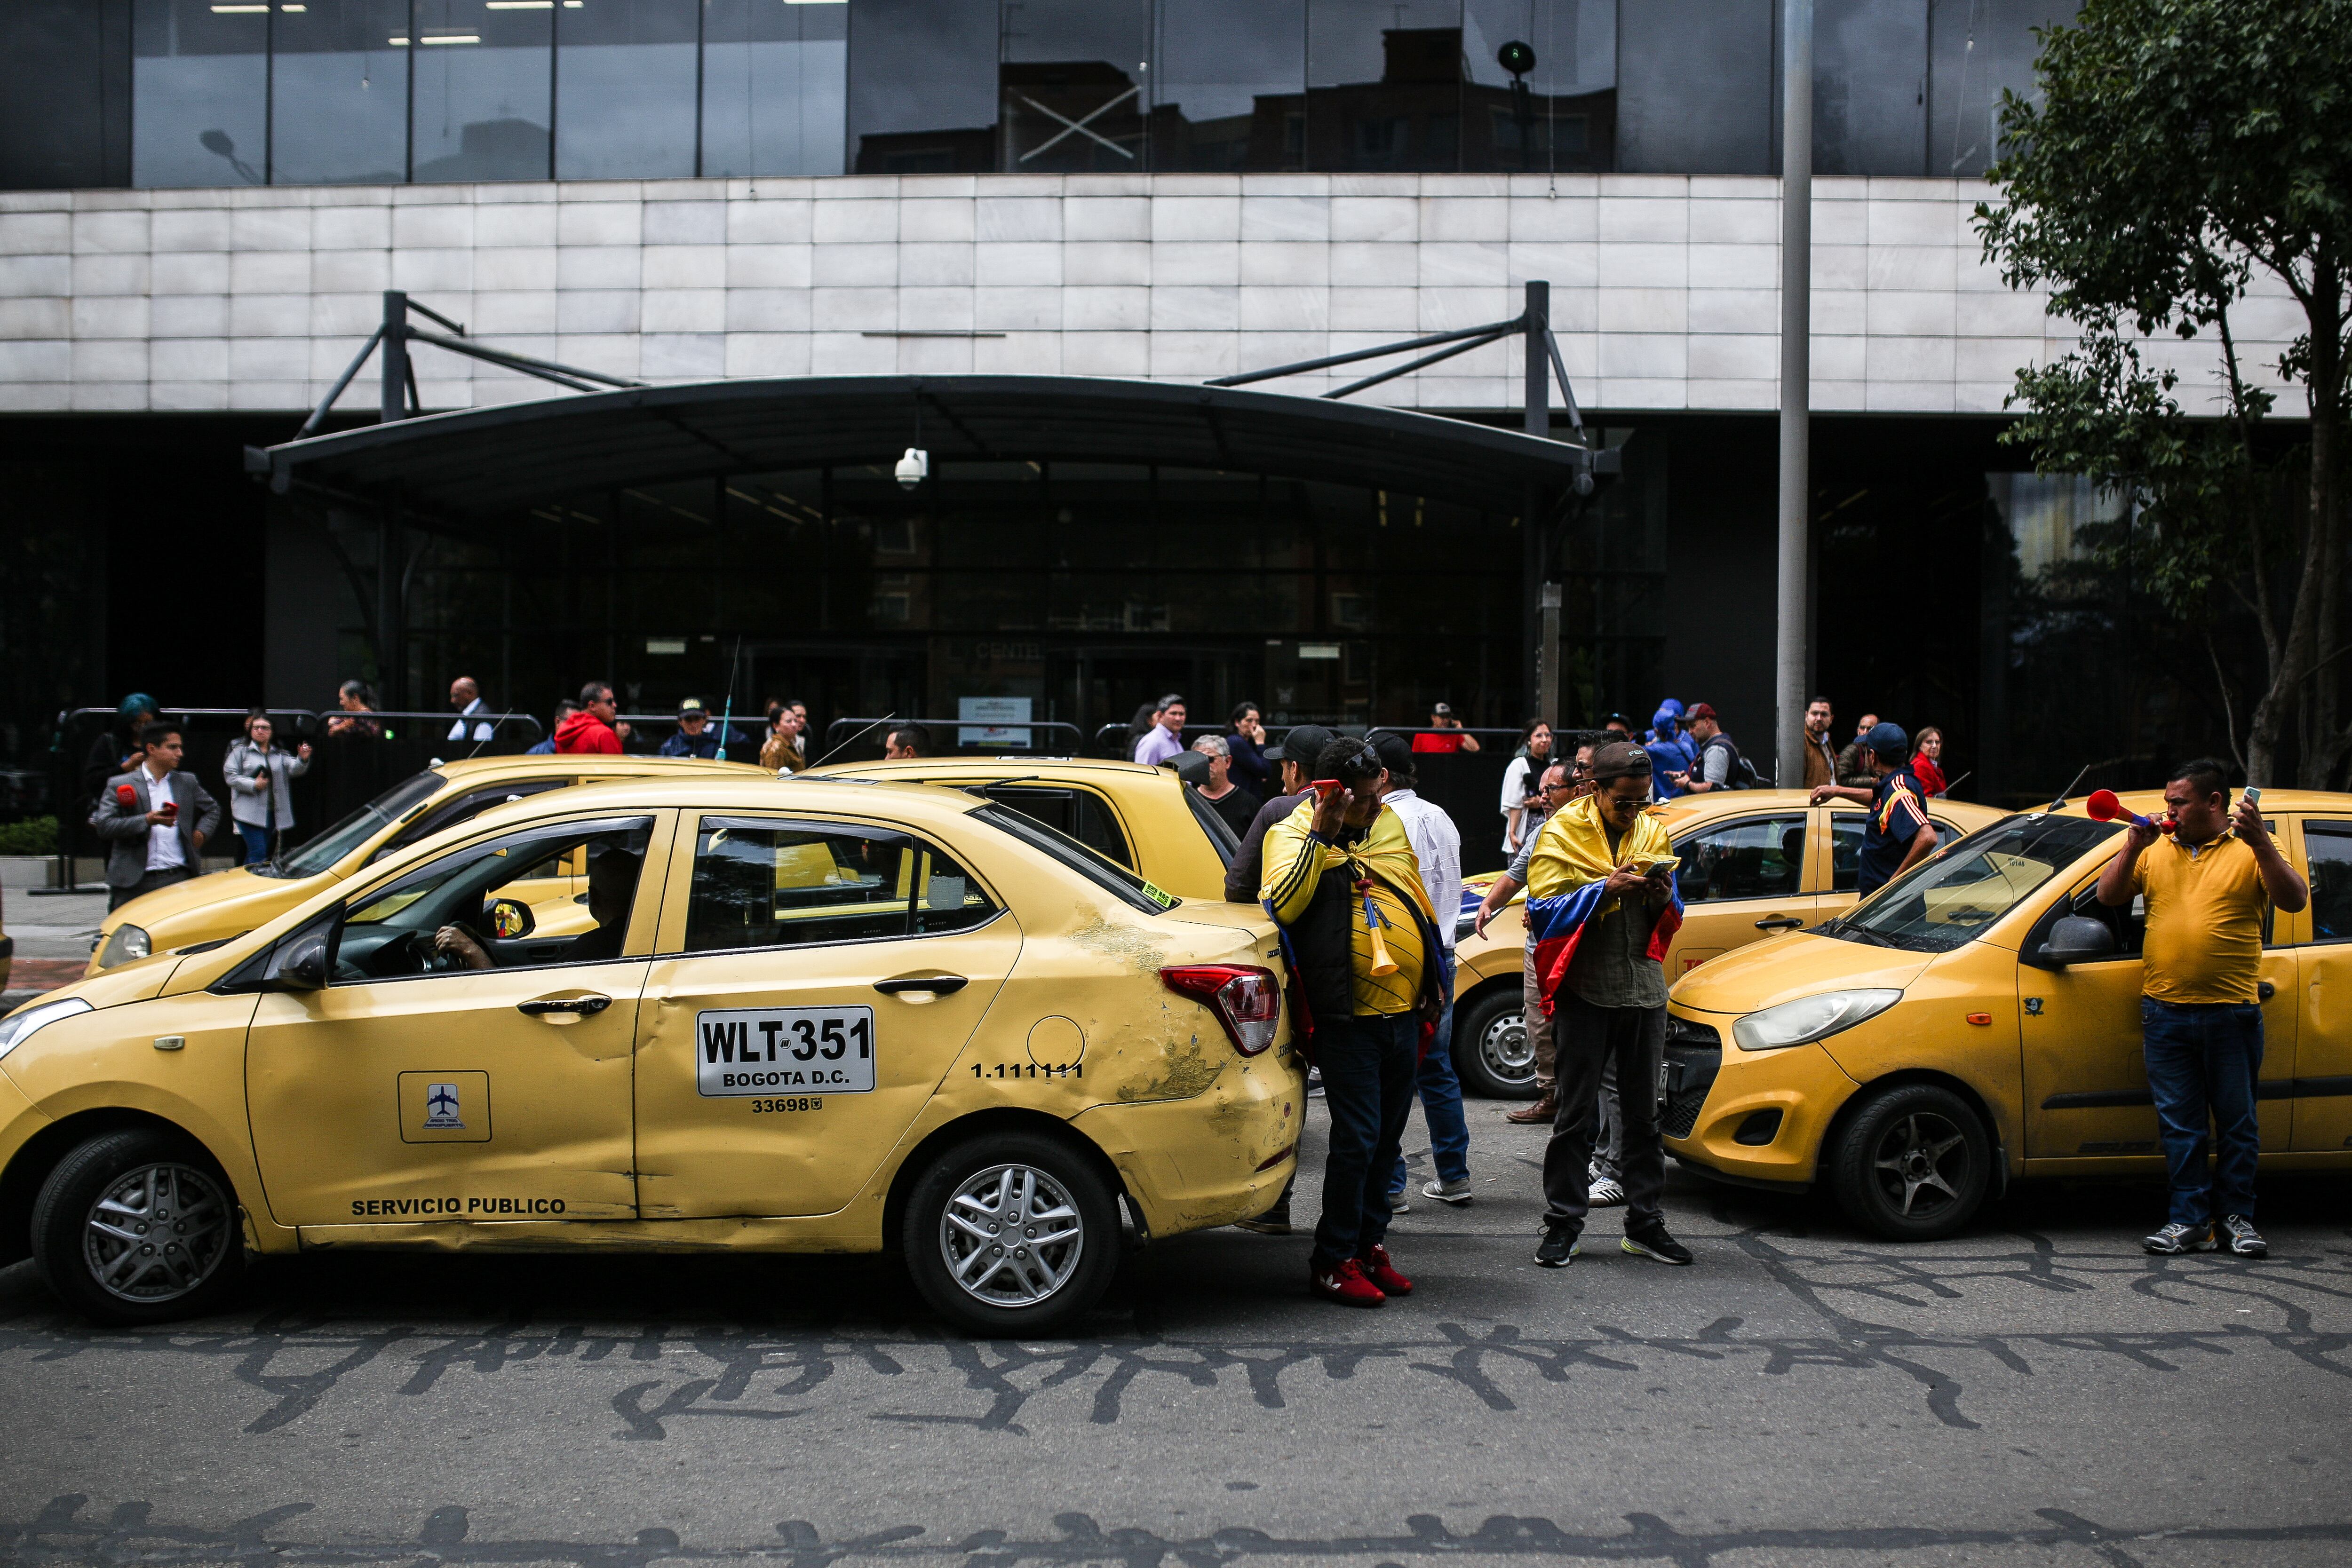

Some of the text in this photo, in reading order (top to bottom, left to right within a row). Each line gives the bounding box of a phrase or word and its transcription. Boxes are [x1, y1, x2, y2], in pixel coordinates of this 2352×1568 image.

[723, 1069, 850, 1087] BOGOTA D.C.
[970, 1063, 1082, 1078] 1.111111
[752, 1098, 810, 1113] 33698
[351, 1197, 566, 1215] SERVICIO PUBLICO
